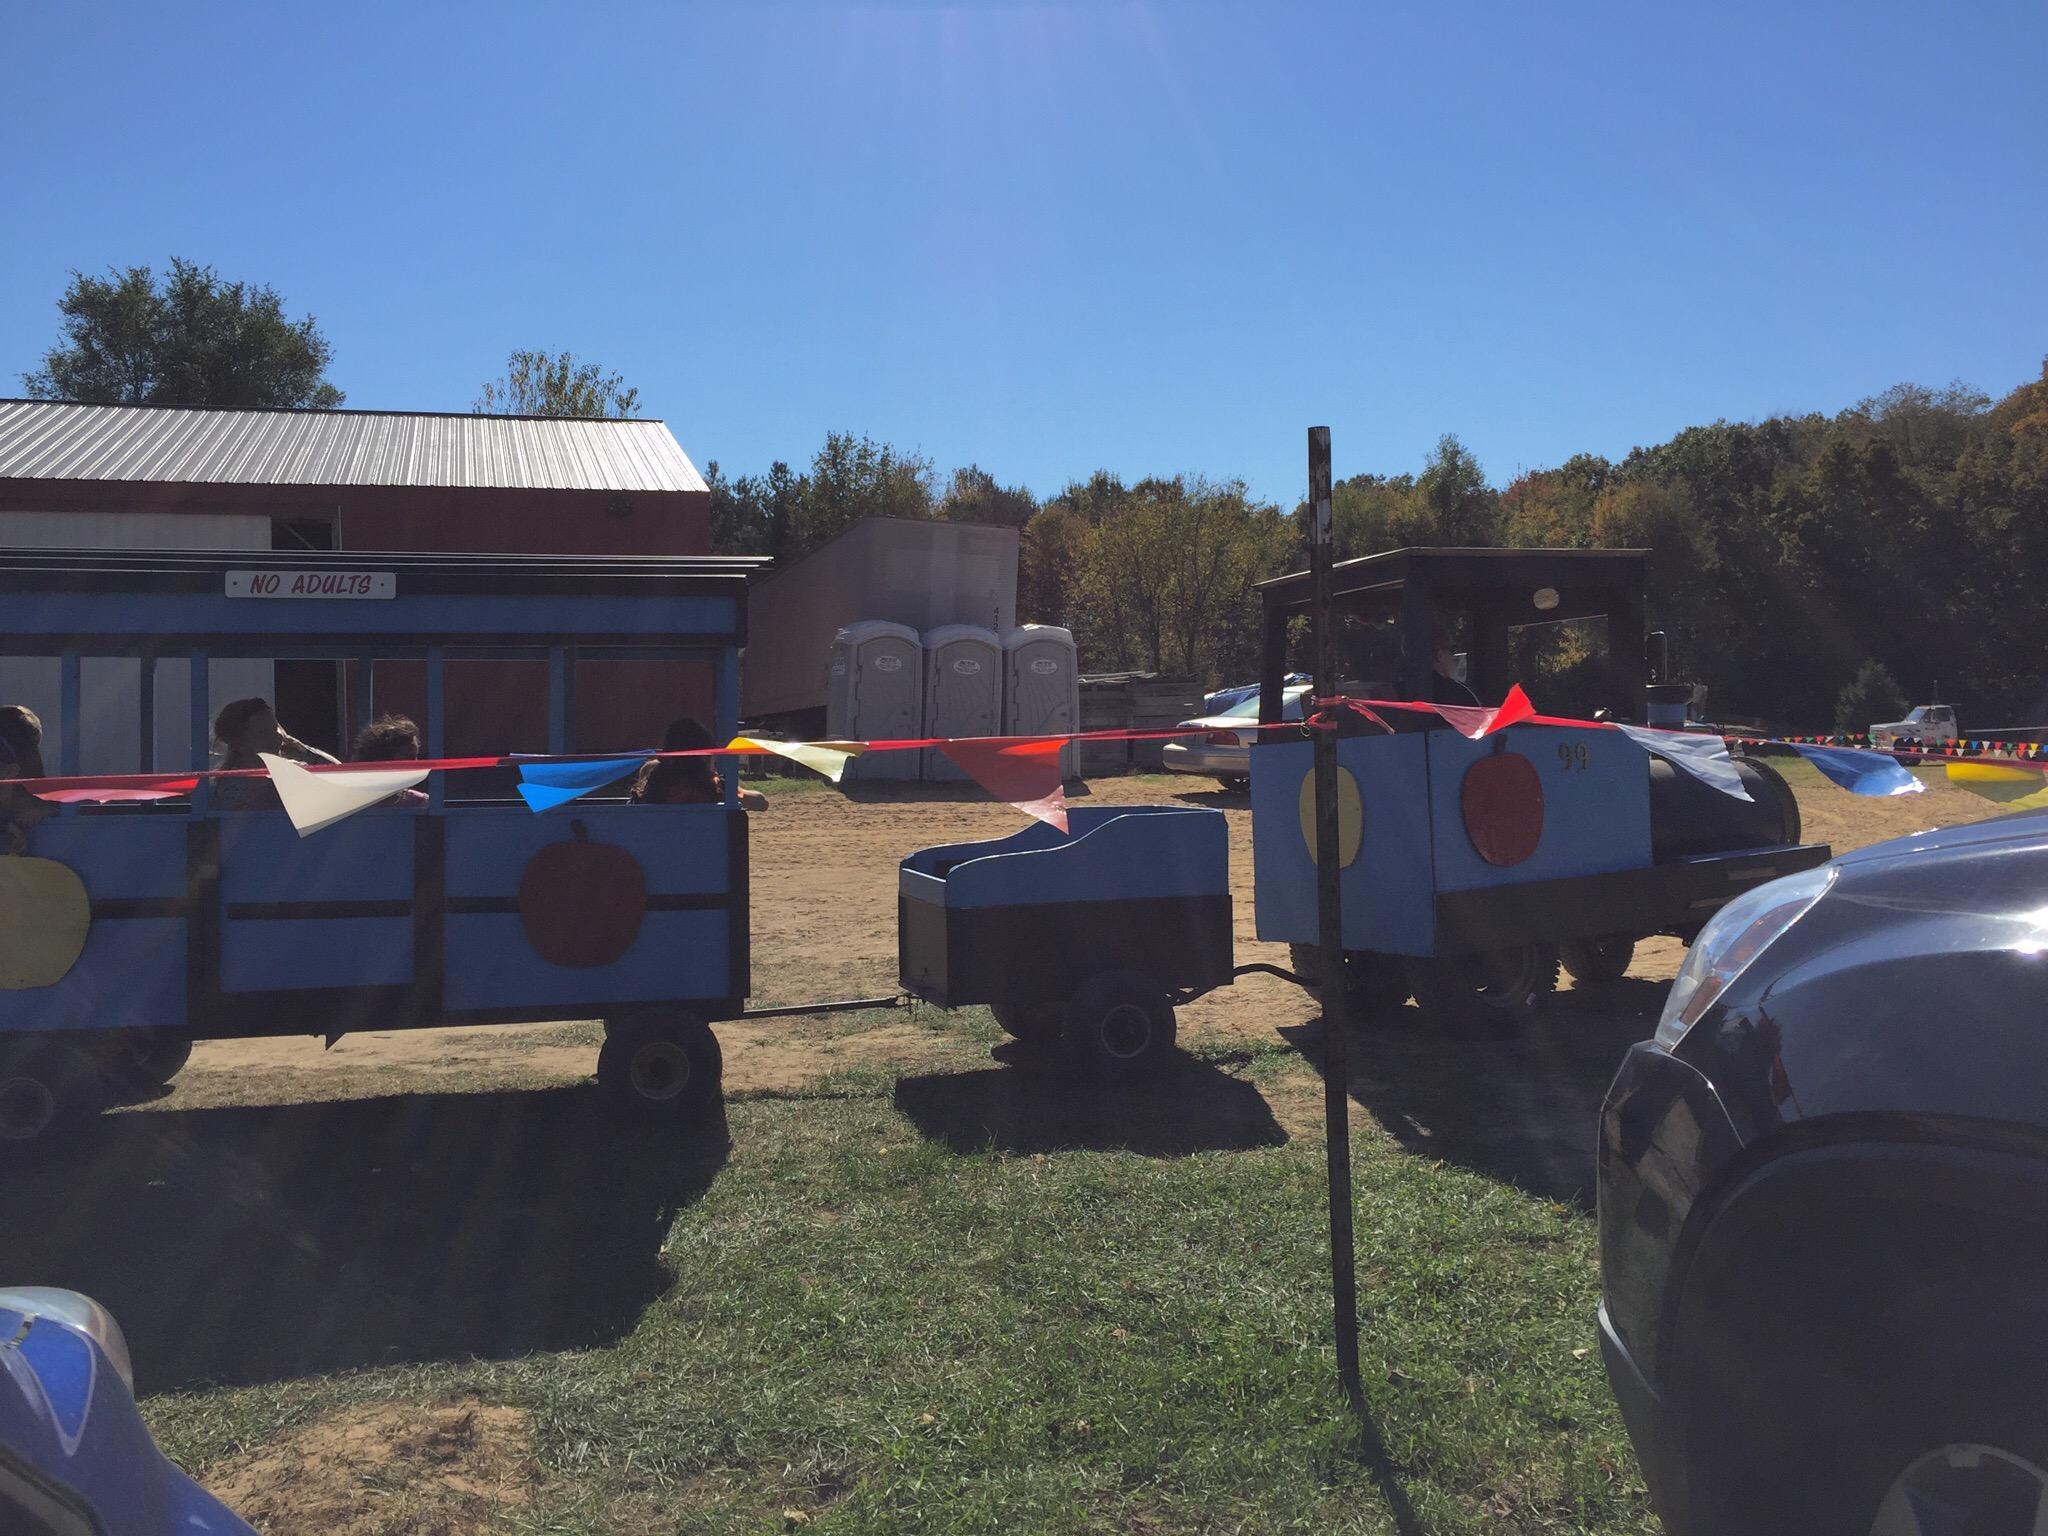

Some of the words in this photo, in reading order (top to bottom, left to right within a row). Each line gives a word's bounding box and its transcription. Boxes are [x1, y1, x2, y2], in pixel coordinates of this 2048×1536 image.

[249, 574, 280, 594] NO
[291, 574, 371, 595] ADULTS
[1558, 741, 1589, 773] 99
